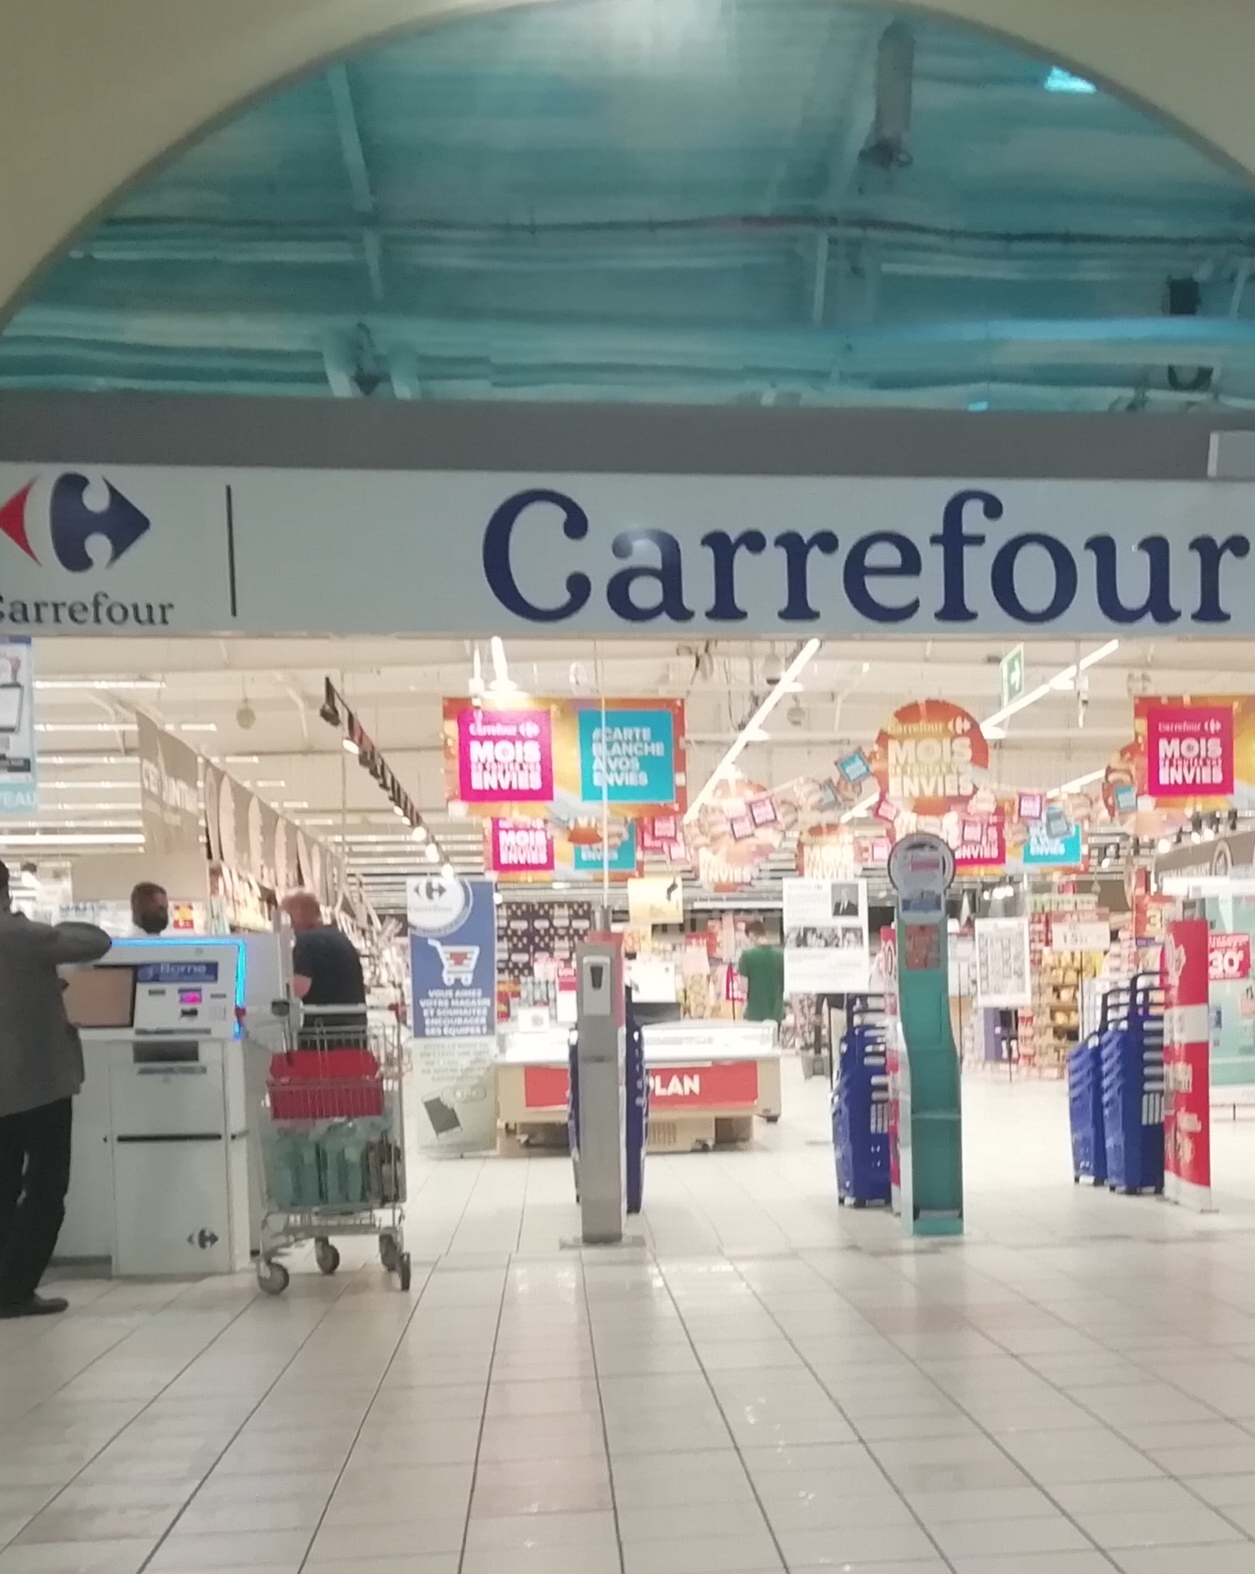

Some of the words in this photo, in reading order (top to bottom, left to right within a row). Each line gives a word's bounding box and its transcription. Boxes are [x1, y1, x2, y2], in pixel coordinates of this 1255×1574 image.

[482, 487, 1250, 624] Carrefour
[0, 590, 174, 625] arrefour
[1158, 721, 1201, 733] Carrefour
[469, 740, 541, 763] MOIS
[592, 741, 664, 757] BLANCHE
[888, 736, 973, 764] MOIS
[1158, 737, 1222, 759] MOIS
[471, 770, 543, 791] ENVIES
[889, 774, 974, 798] ENVIES
[1158, 766, 1223, 786] ENVIES
